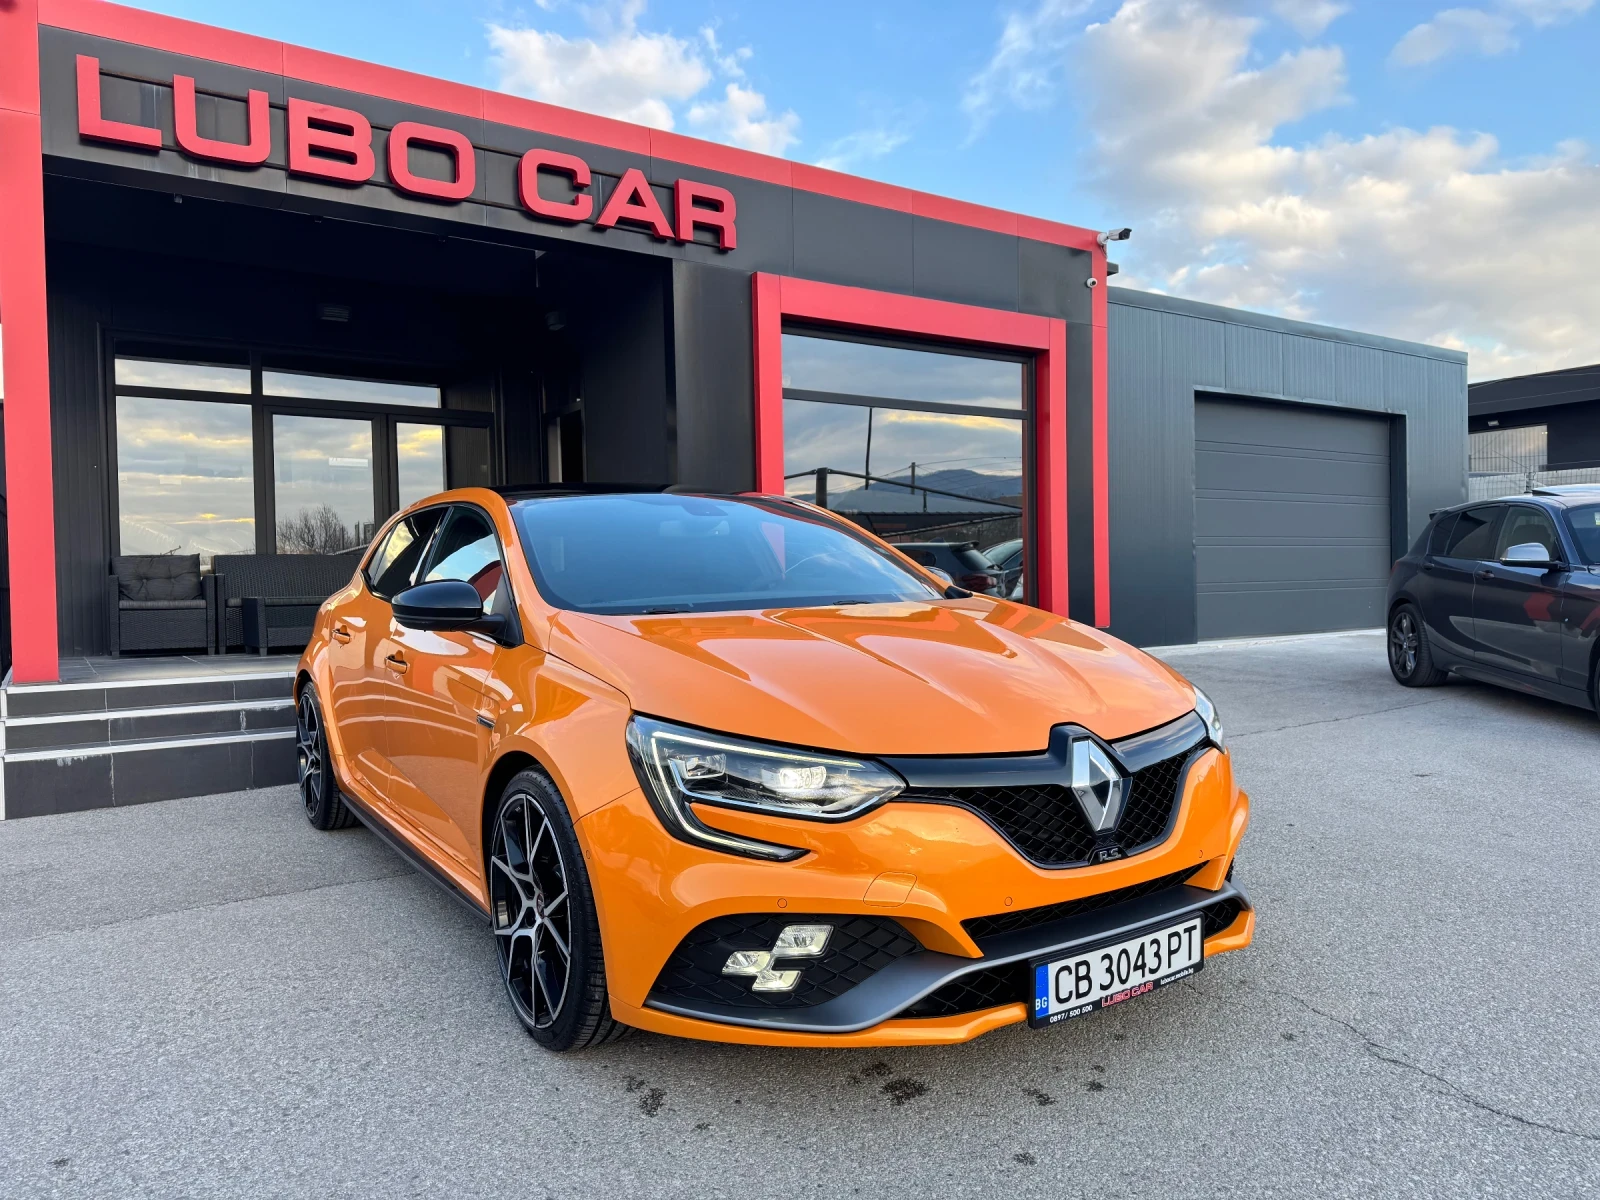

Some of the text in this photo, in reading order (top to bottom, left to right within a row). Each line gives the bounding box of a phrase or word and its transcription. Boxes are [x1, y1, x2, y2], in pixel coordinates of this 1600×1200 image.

[76, 54, 737, 251] LUBO CAR
[1055, 925, 1197, 1004] CB 3043 PT
[1035, 996, 1047, 1010] BG
[1102, 981, 1154, 1007] LUBO CAR
[1069, 1008, 1080, 1017] 500
